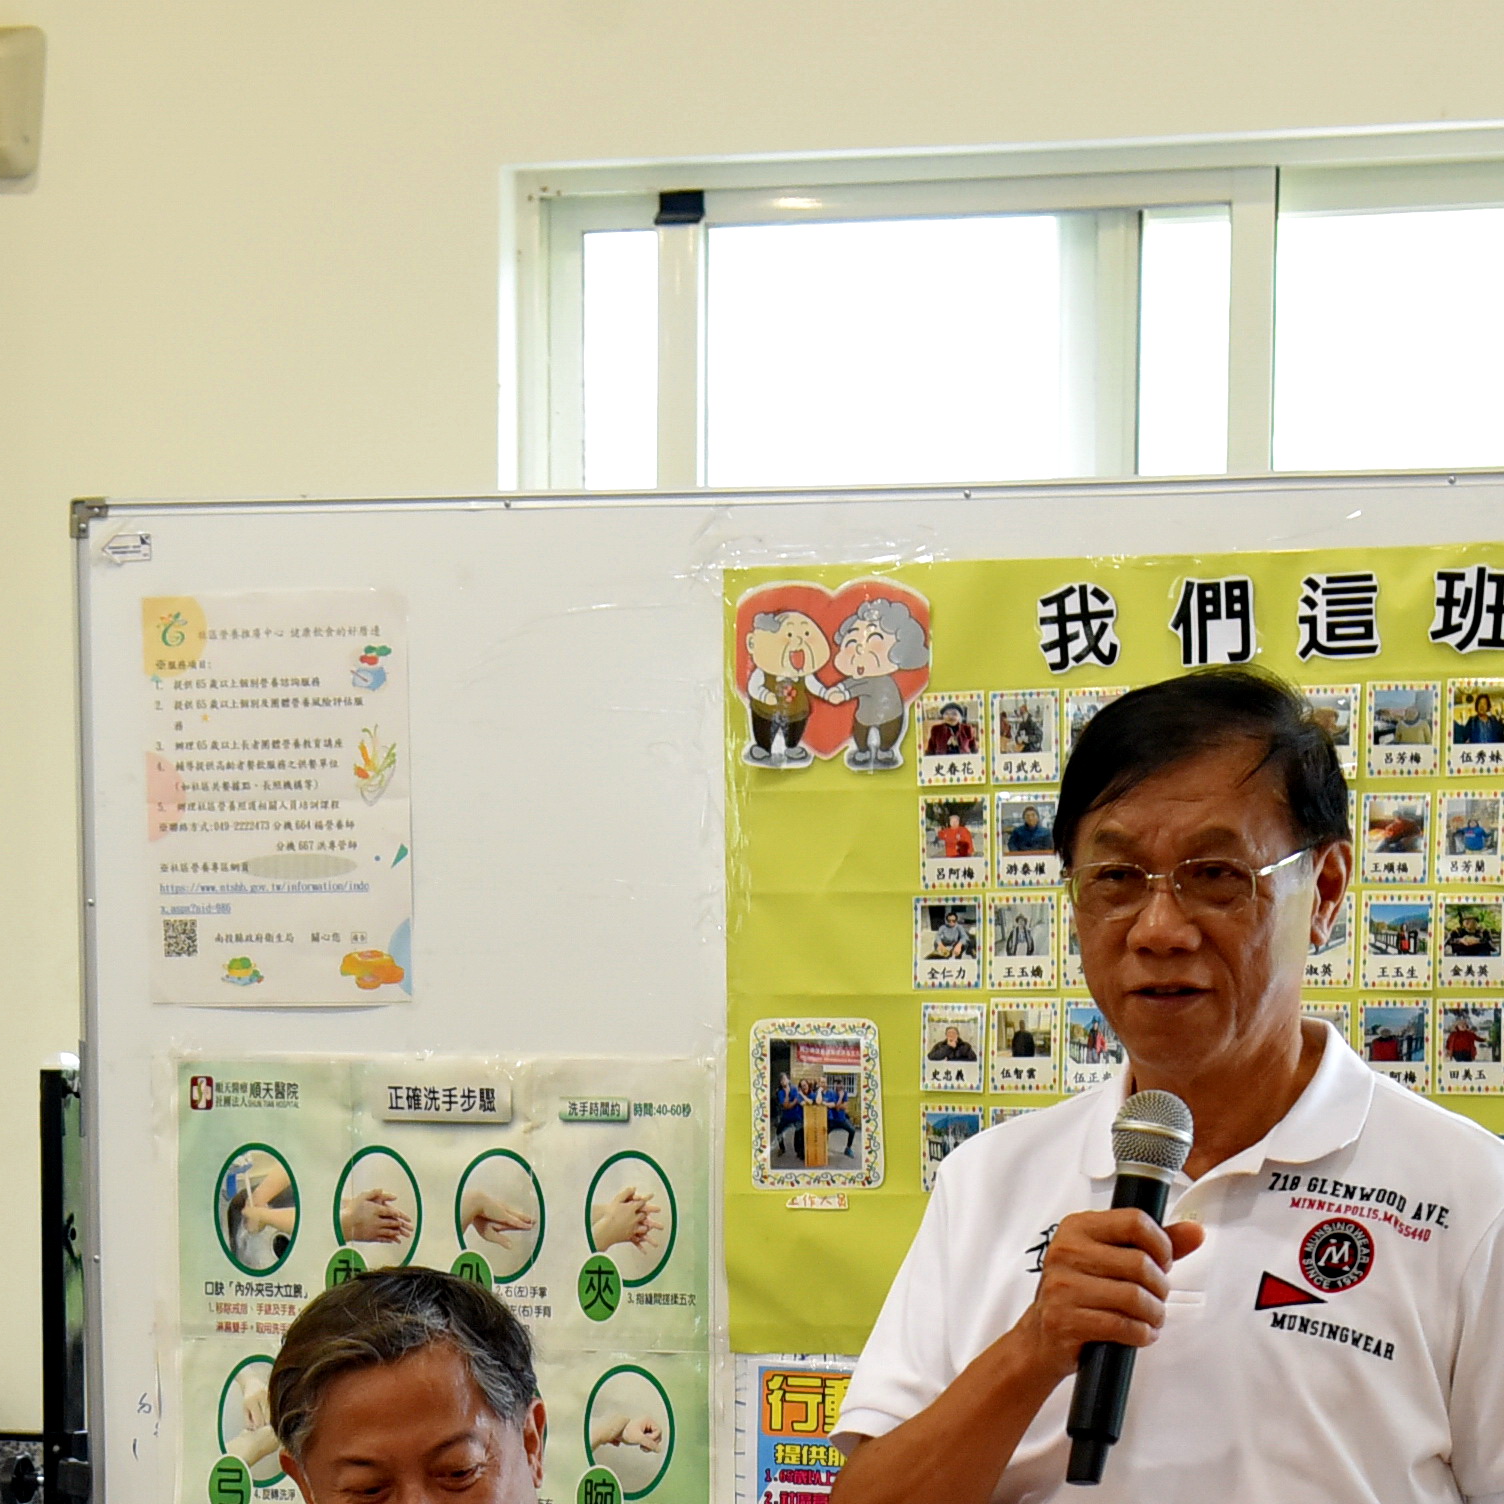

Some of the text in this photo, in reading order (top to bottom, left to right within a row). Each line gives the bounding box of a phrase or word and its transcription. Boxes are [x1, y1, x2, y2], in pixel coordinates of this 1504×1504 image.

[1384, 752, 1421, 764] 呂芳梅
[934, 762, 974, 776] 史春花
[1003, 760, 1042, 774] 司武光
[937, 866, 974, 880] 呂阿梅
[1371, 862, 1409, 875] 王順福
[1450, 860, 1486, 873] 呂芳蘭
[927, 966, 966, 980] 全仁力
[1378, 966, 1418, 979] 王玉生
[1450, 964, 1489, 977] 金美英
[1380, 1069, 1417, 1084] 阿梅
[1449, 1069, 1486, 1081] 田美玉
[249, 1081, 299, 1100] 順天醫院
[388, 1086, 496, 1113] 正確洗手步驟
[568, 1101, 621, 1117] 洗手時間約
[1307, 1177, 1407, 1213] GLENWOOD
[1412, 1202, 1450, 1229] AVE.
[1303, 1222, 1370, 1264] MUNSINGWEAR
[1302, 1258, 1330, 1290] SINCE
[584, 1265, 615, 1312] 夾
[1270, 1312, 1395, 1360] MUNSINGWEAR
